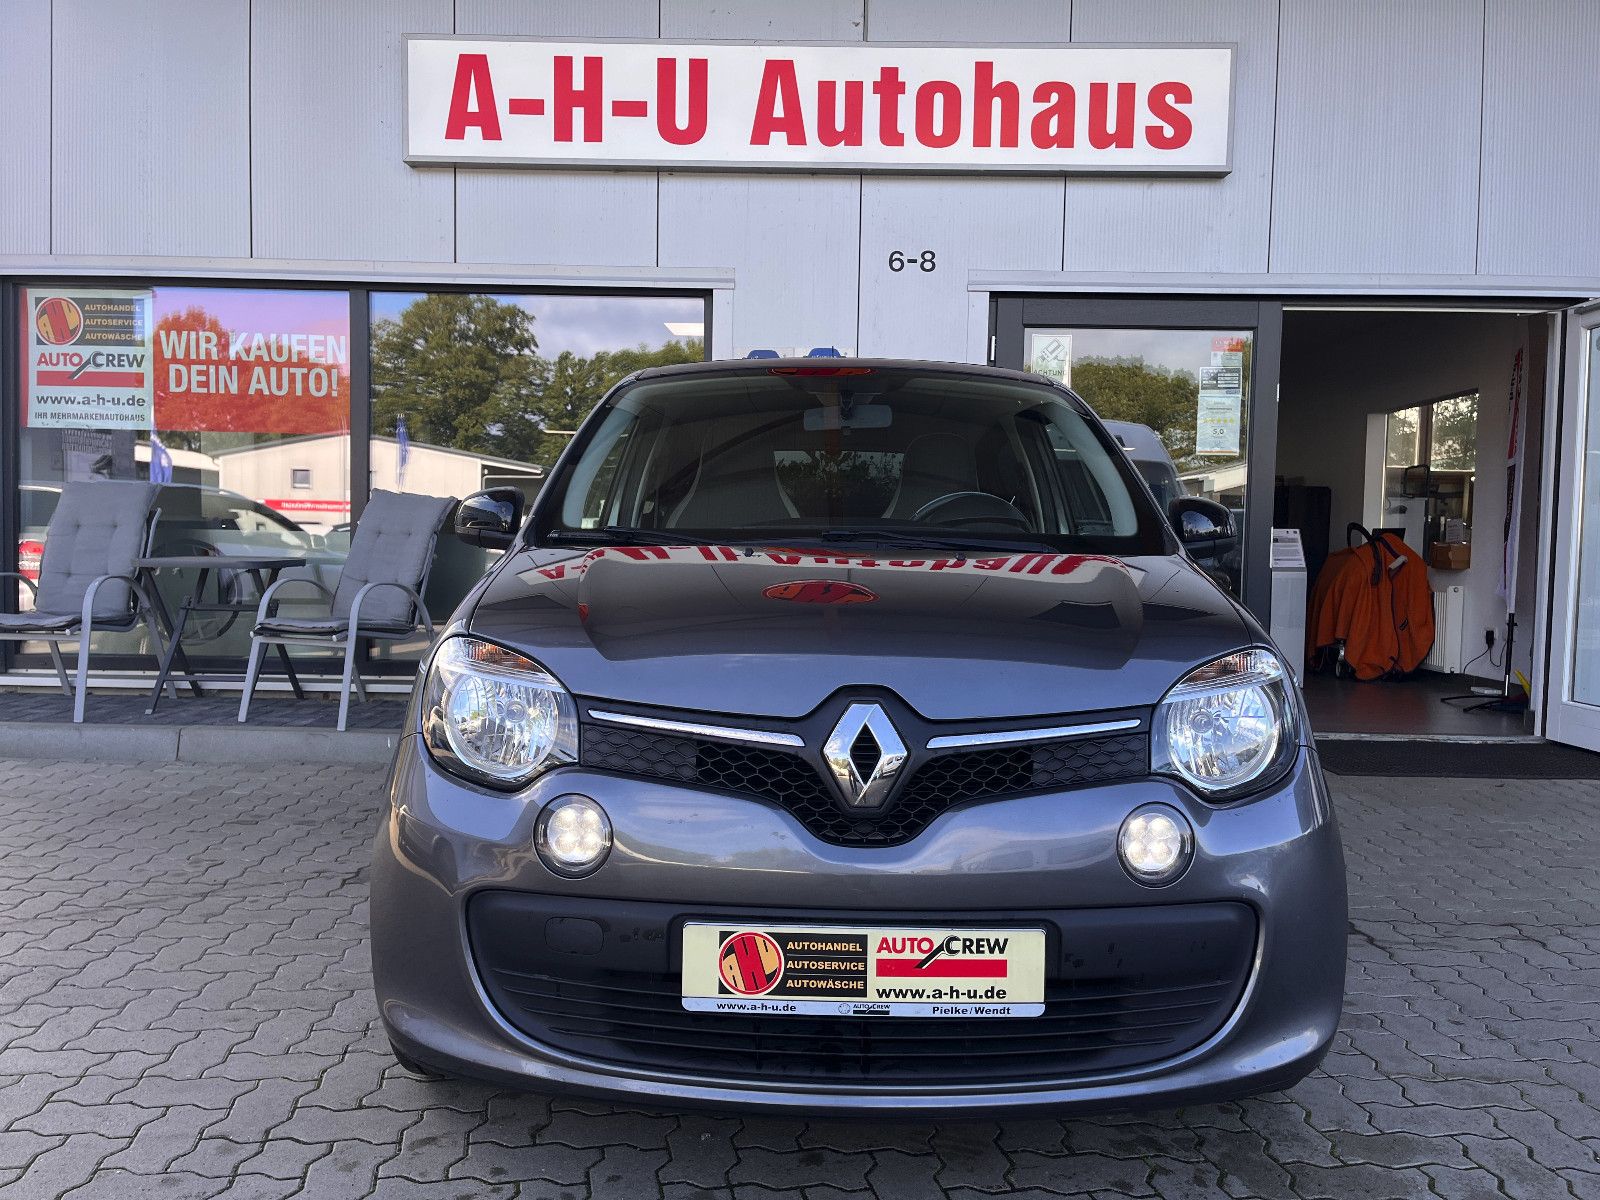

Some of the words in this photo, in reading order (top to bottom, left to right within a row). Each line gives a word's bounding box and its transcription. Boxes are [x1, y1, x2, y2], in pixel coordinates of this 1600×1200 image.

[444, 53, 709, 146] A-H-U
[750, 59, 1193, 150] Autohaus
[888, 250, 936, 273] 6-8
[84, 304, 141, 312] AUTOHANDEL
[84, 318, 143, 327] AUTOSERVICE
[159, 330, 219, 361] WIR
[229, 332, 346, 364] KAUFEN
[37, 352, 84, 367] AUTO
[91, 351, 145, 368] CREW
[168, 363, 239, 395] DEIN
[248, 366, 338, 398] AUTO!
[36, 394, 146, 407] www.a-h-u.de
[34, 412, 48, 420] IHR
[50, 412, 145, 422] MEHRMARKENAUTOHAUS
[786, 941, 863, 952] AUTOHANDEL
[876, 936, 935, 954] AUTO
[945, 935, 1009, 955] CREW
[786, 960, 866, 971] AUTOSERVICE
[786, 978, 865, 989] AUTOWÄSCHE
[876, 985, 1007, 999] www.a-h-u.de
[716, 1002, 797, 1012] www.a-h-u.de
[932, 1006, 1011, 1015] Pielke/Wendt
